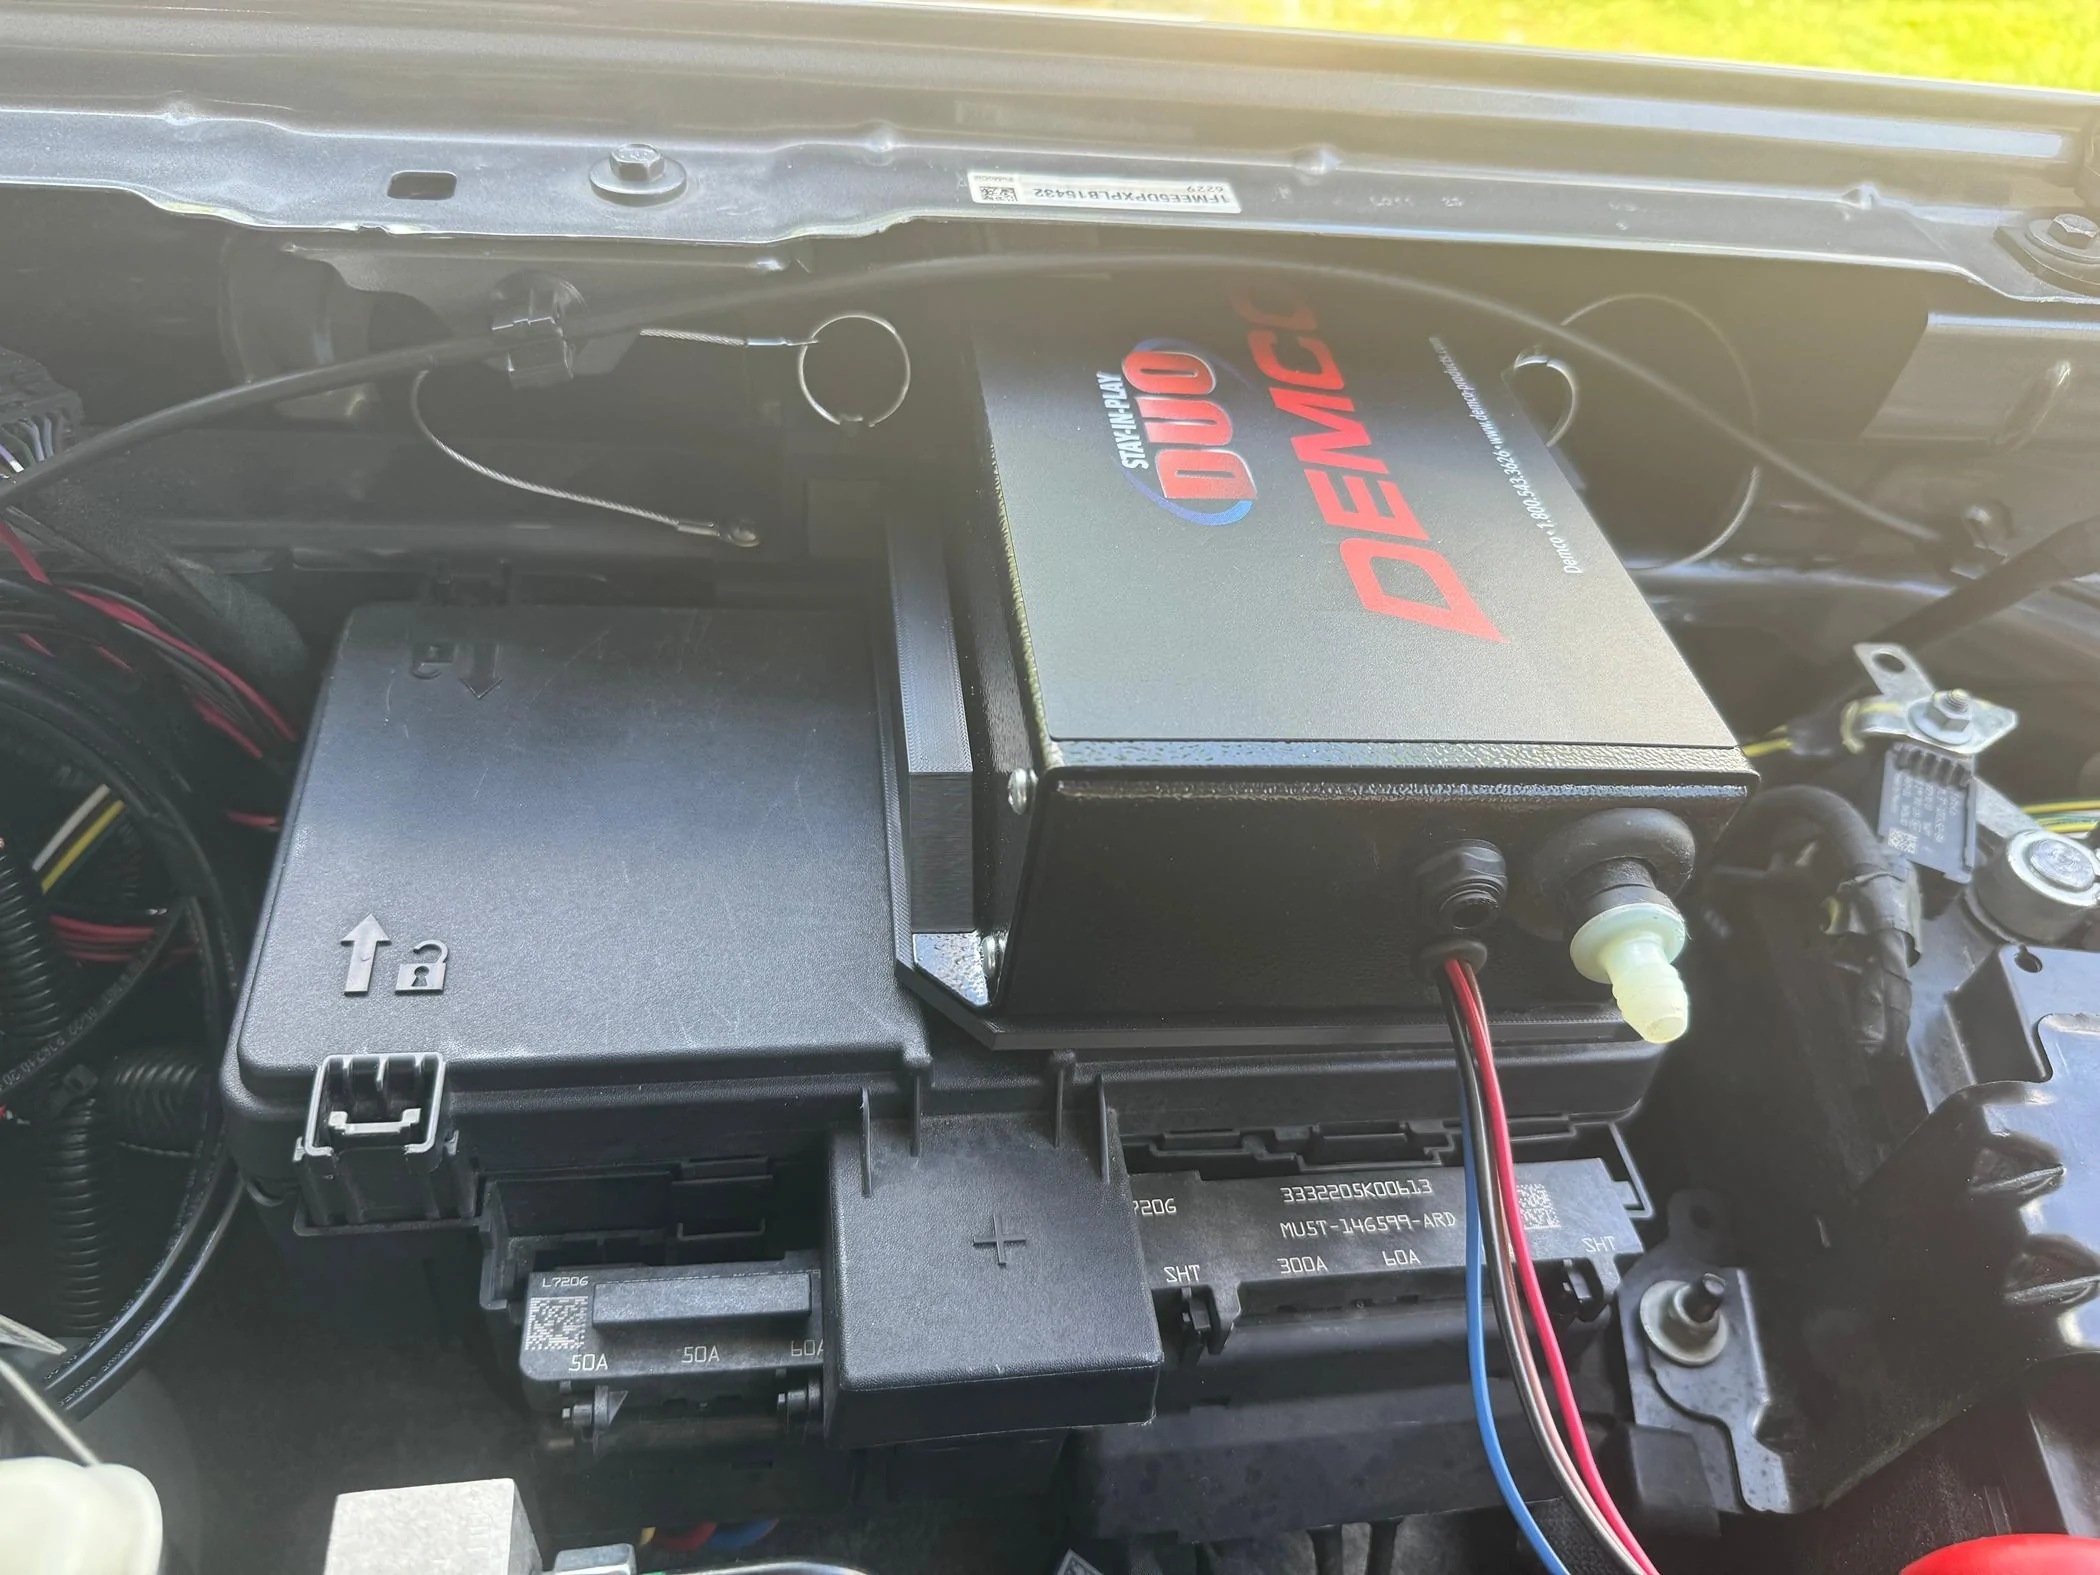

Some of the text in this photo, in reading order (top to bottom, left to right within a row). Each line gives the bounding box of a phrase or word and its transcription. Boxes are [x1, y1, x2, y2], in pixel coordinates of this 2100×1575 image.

[1096, 370, 1150, 470] STAY-IN-PLAY
[1121, 351, 1258, 499] DUO
[1493, 449, 1555, 530] 1.800.543.3626
[1549, 537, 1584, 574] Demco
[1164, 1236, 1616, 1283] SHT 300A 60A SHT
[568, 1353, 609, 1372] 50A
[682, 1345, 720, 1363] 50A
